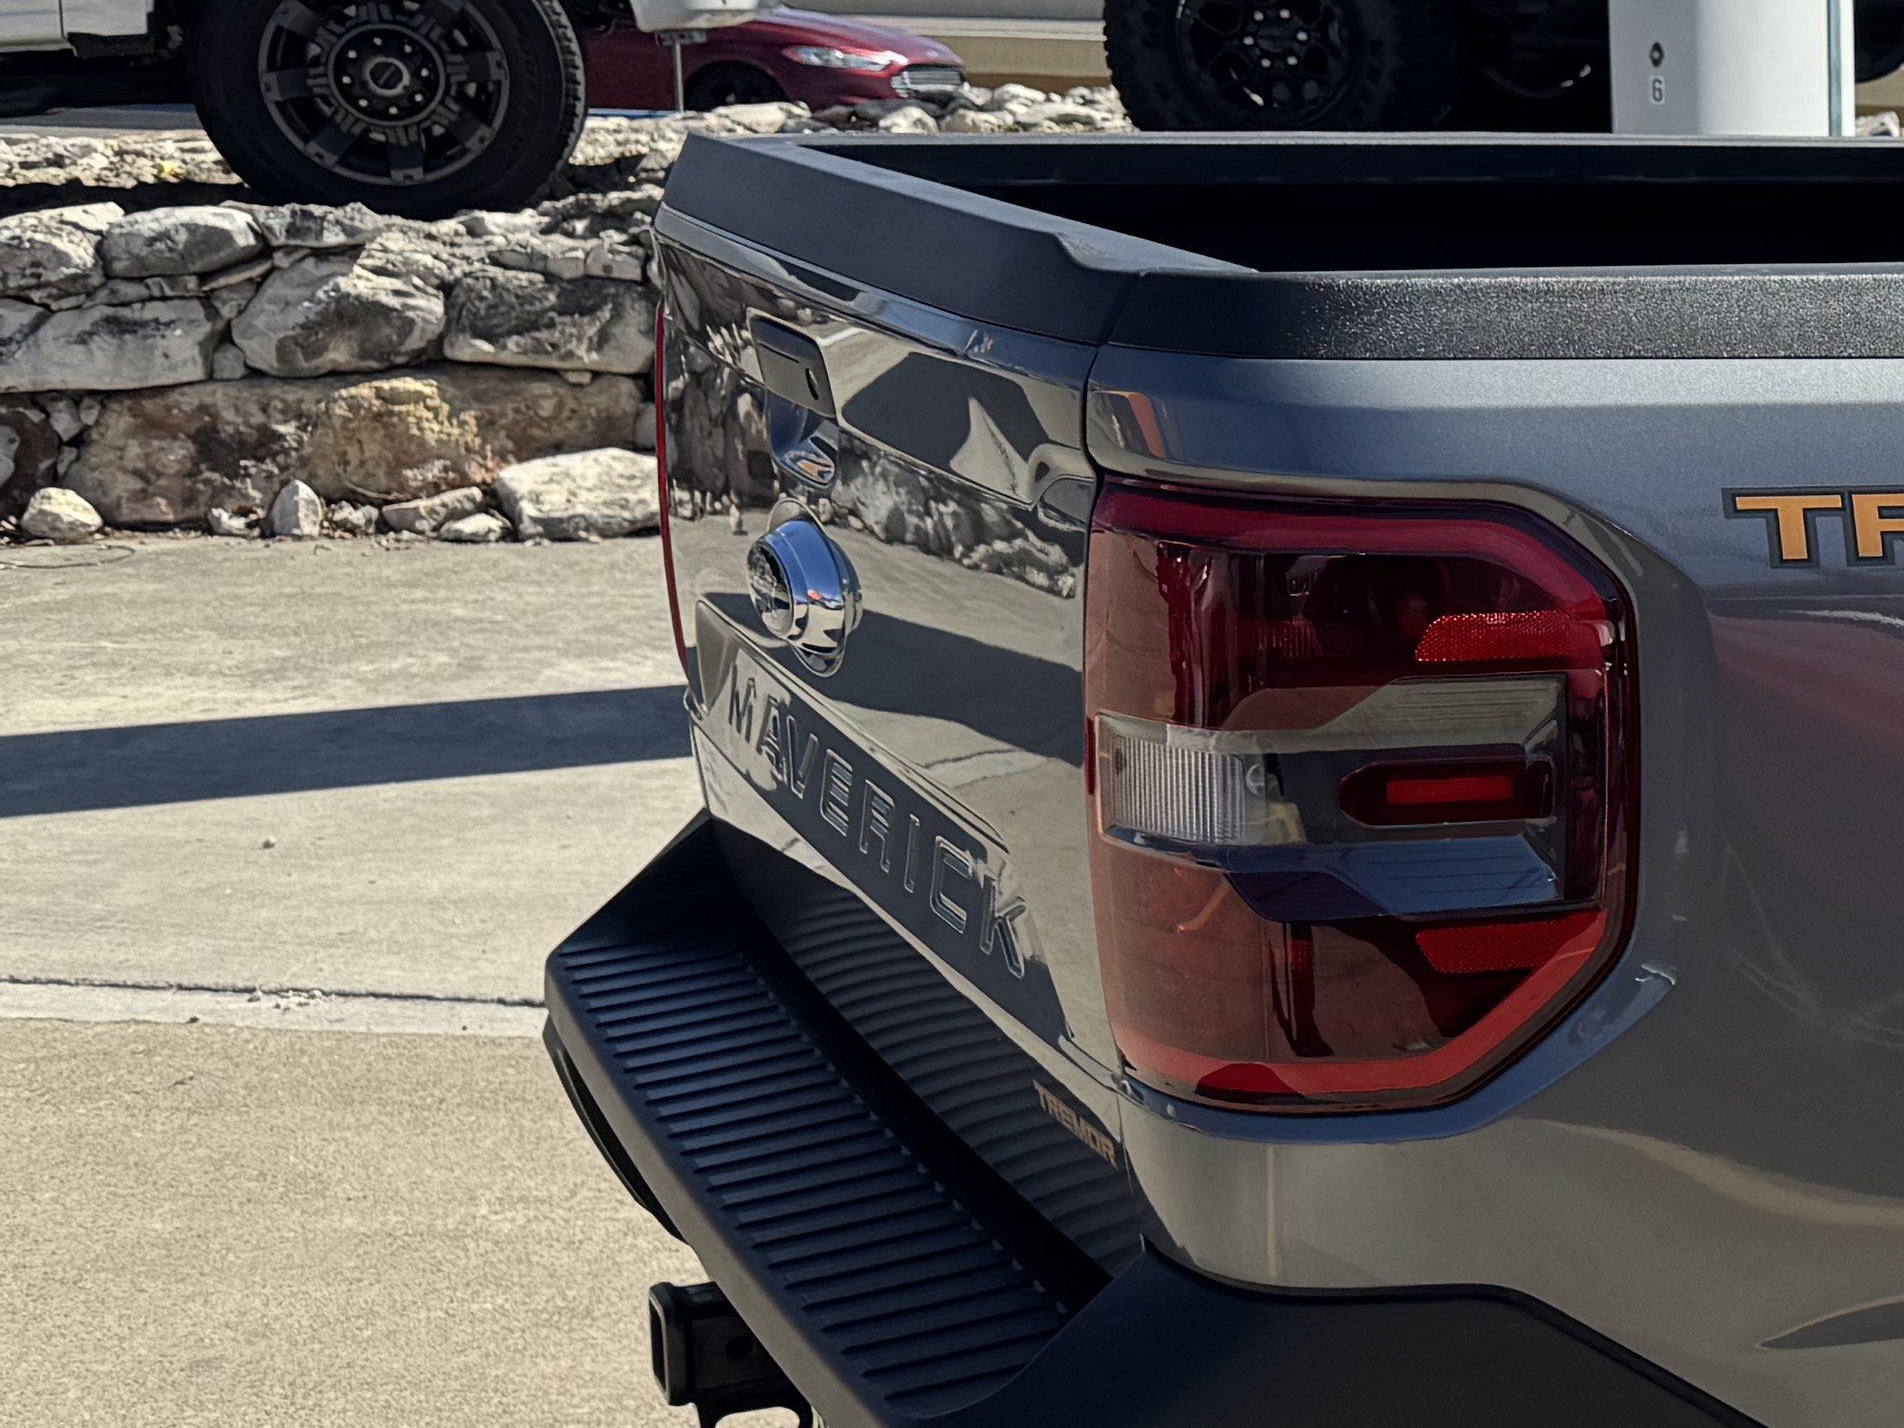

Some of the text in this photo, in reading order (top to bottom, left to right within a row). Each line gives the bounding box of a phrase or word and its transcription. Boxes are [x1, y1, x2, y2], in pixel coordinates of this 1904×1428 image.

[1651, 77, 1663, 102] 6
[729, 659, 1027, 980] MAVERICK
[1033, 1080, 1120, 1170] TREMOR
